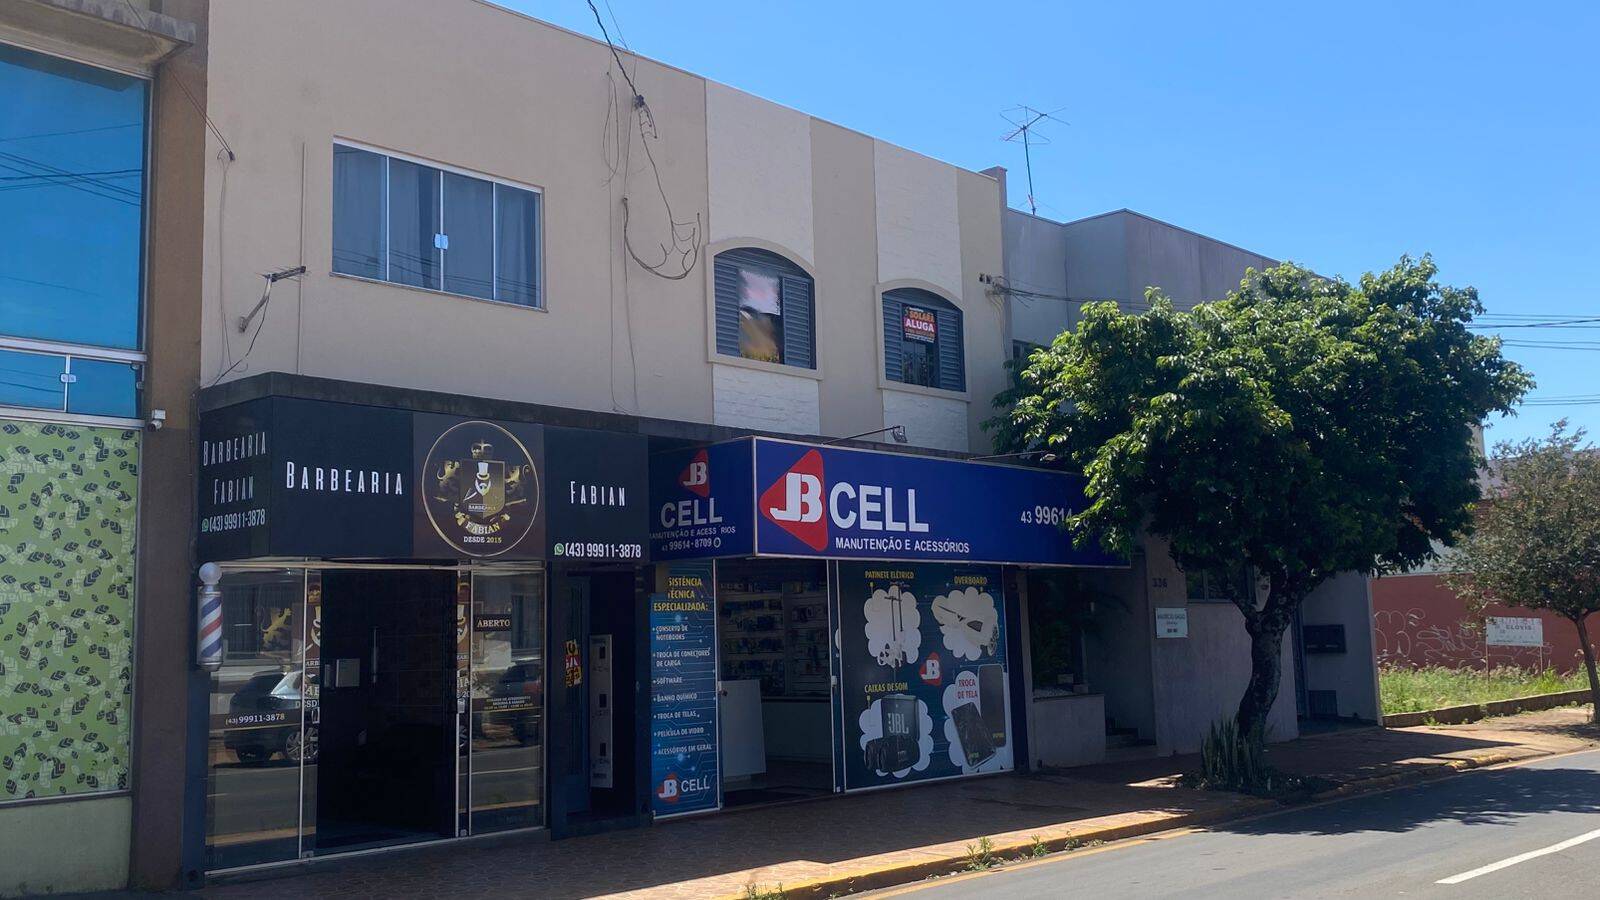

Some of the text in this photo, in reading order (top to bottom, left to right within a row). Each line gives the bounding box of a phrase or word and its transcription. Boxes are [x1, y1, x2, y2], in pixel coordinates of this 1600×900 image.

[905, 318, 935, 332] ALUGA
[203, 432, 266, 466] BARBEARIA
[286, 461, 403, 495] BARBEARIA
[682, 461, 707, 486] JB
[214, 476, 254, 504] FABIAN
[570, 481, 625, 506] FABIAN
[769, 472, 823, 523] JB
[661, 498, 723, 528] CELL
[829, 481, 930, 532] CELL
[209, 508, 266, 533] (43) 99911-3878
[1021, 511, 1032, 523] 43
[466, 520, 500, 535] FABIAN
[690, 530, 696, 538] E
[697, 526, 736, 536] ACESSRIOS
[565, 542, 642, 558] (43) 99911-3878
[835, 536, 970, 553] MANUTENÇÃO E ACESSÓRIOS
[477, 619, 511, 628] ABERTO
[673, 650, 680, 658] DE
[864, 684, 886, 693] CAIXAS
[238, 712, 285, 724] 99911-3878
[681, 777, 710, 792] CELL
